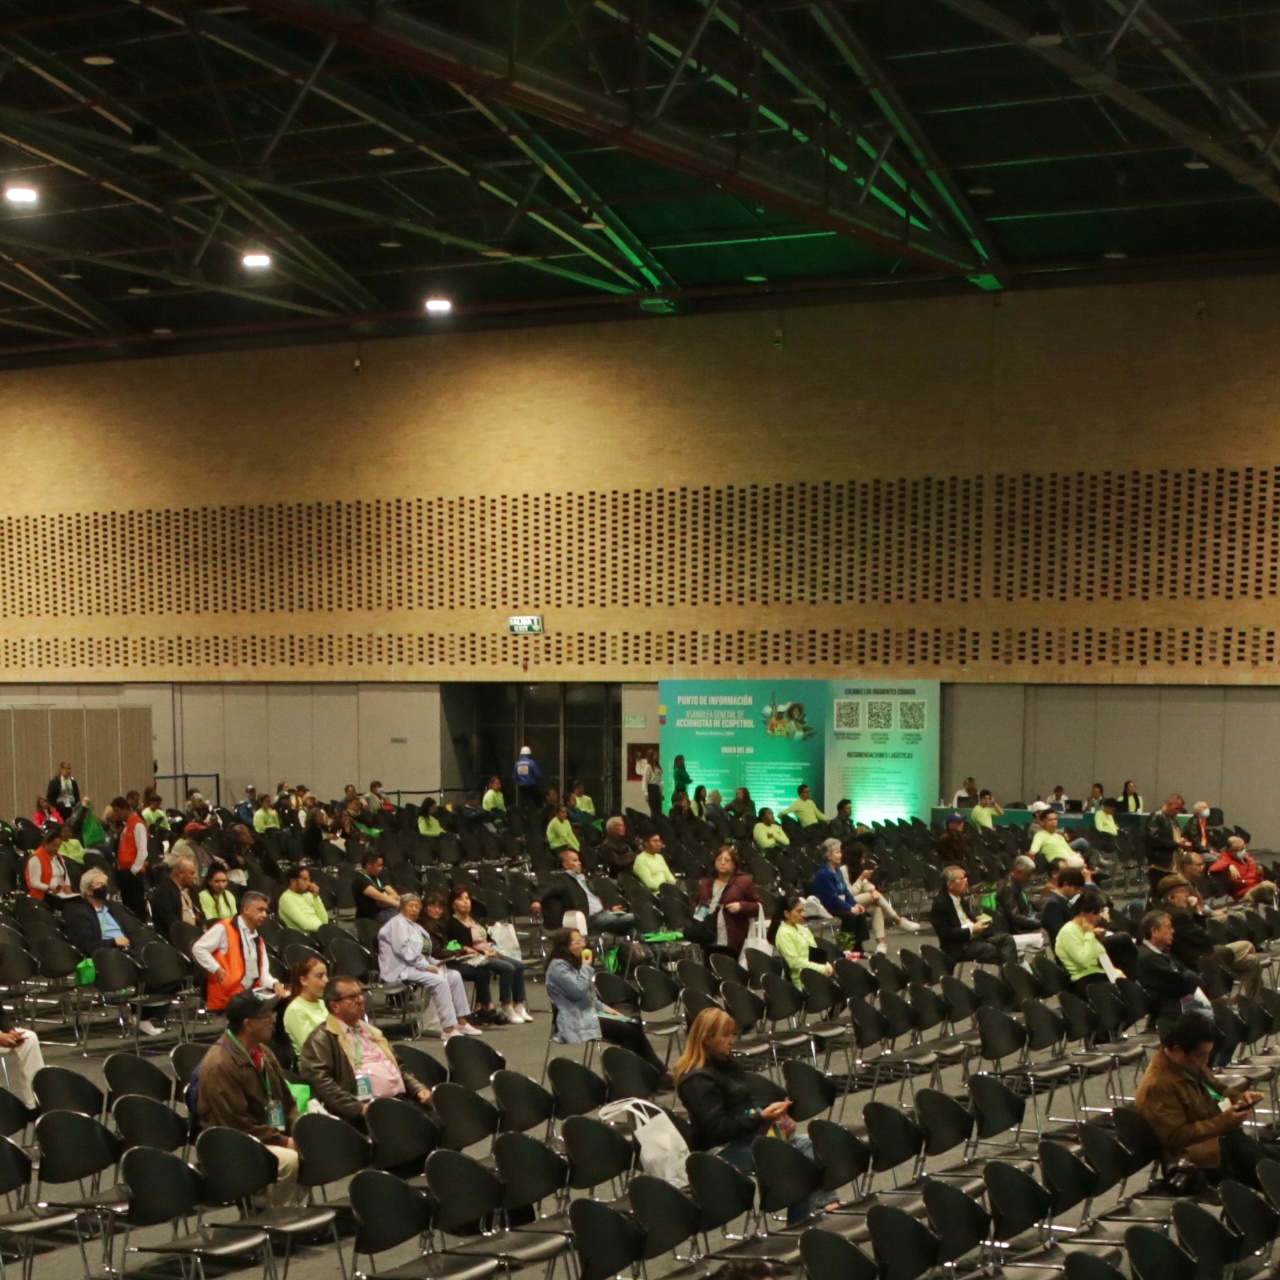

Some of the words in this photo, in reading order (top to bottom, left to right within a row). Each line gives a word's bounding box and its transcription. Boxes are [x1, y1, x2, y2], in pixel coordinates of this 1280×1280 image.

[677, 695, 698, 705] PUNTO
[699, 695, 708, 705] DE
[708, 694, 753, 705] INFORMACIÓN
[675, 719, 712, 727] ACCIONISTAS
[713, 719, 721, 727] DE
[721, 719, 755, 728] ECOPETROL
